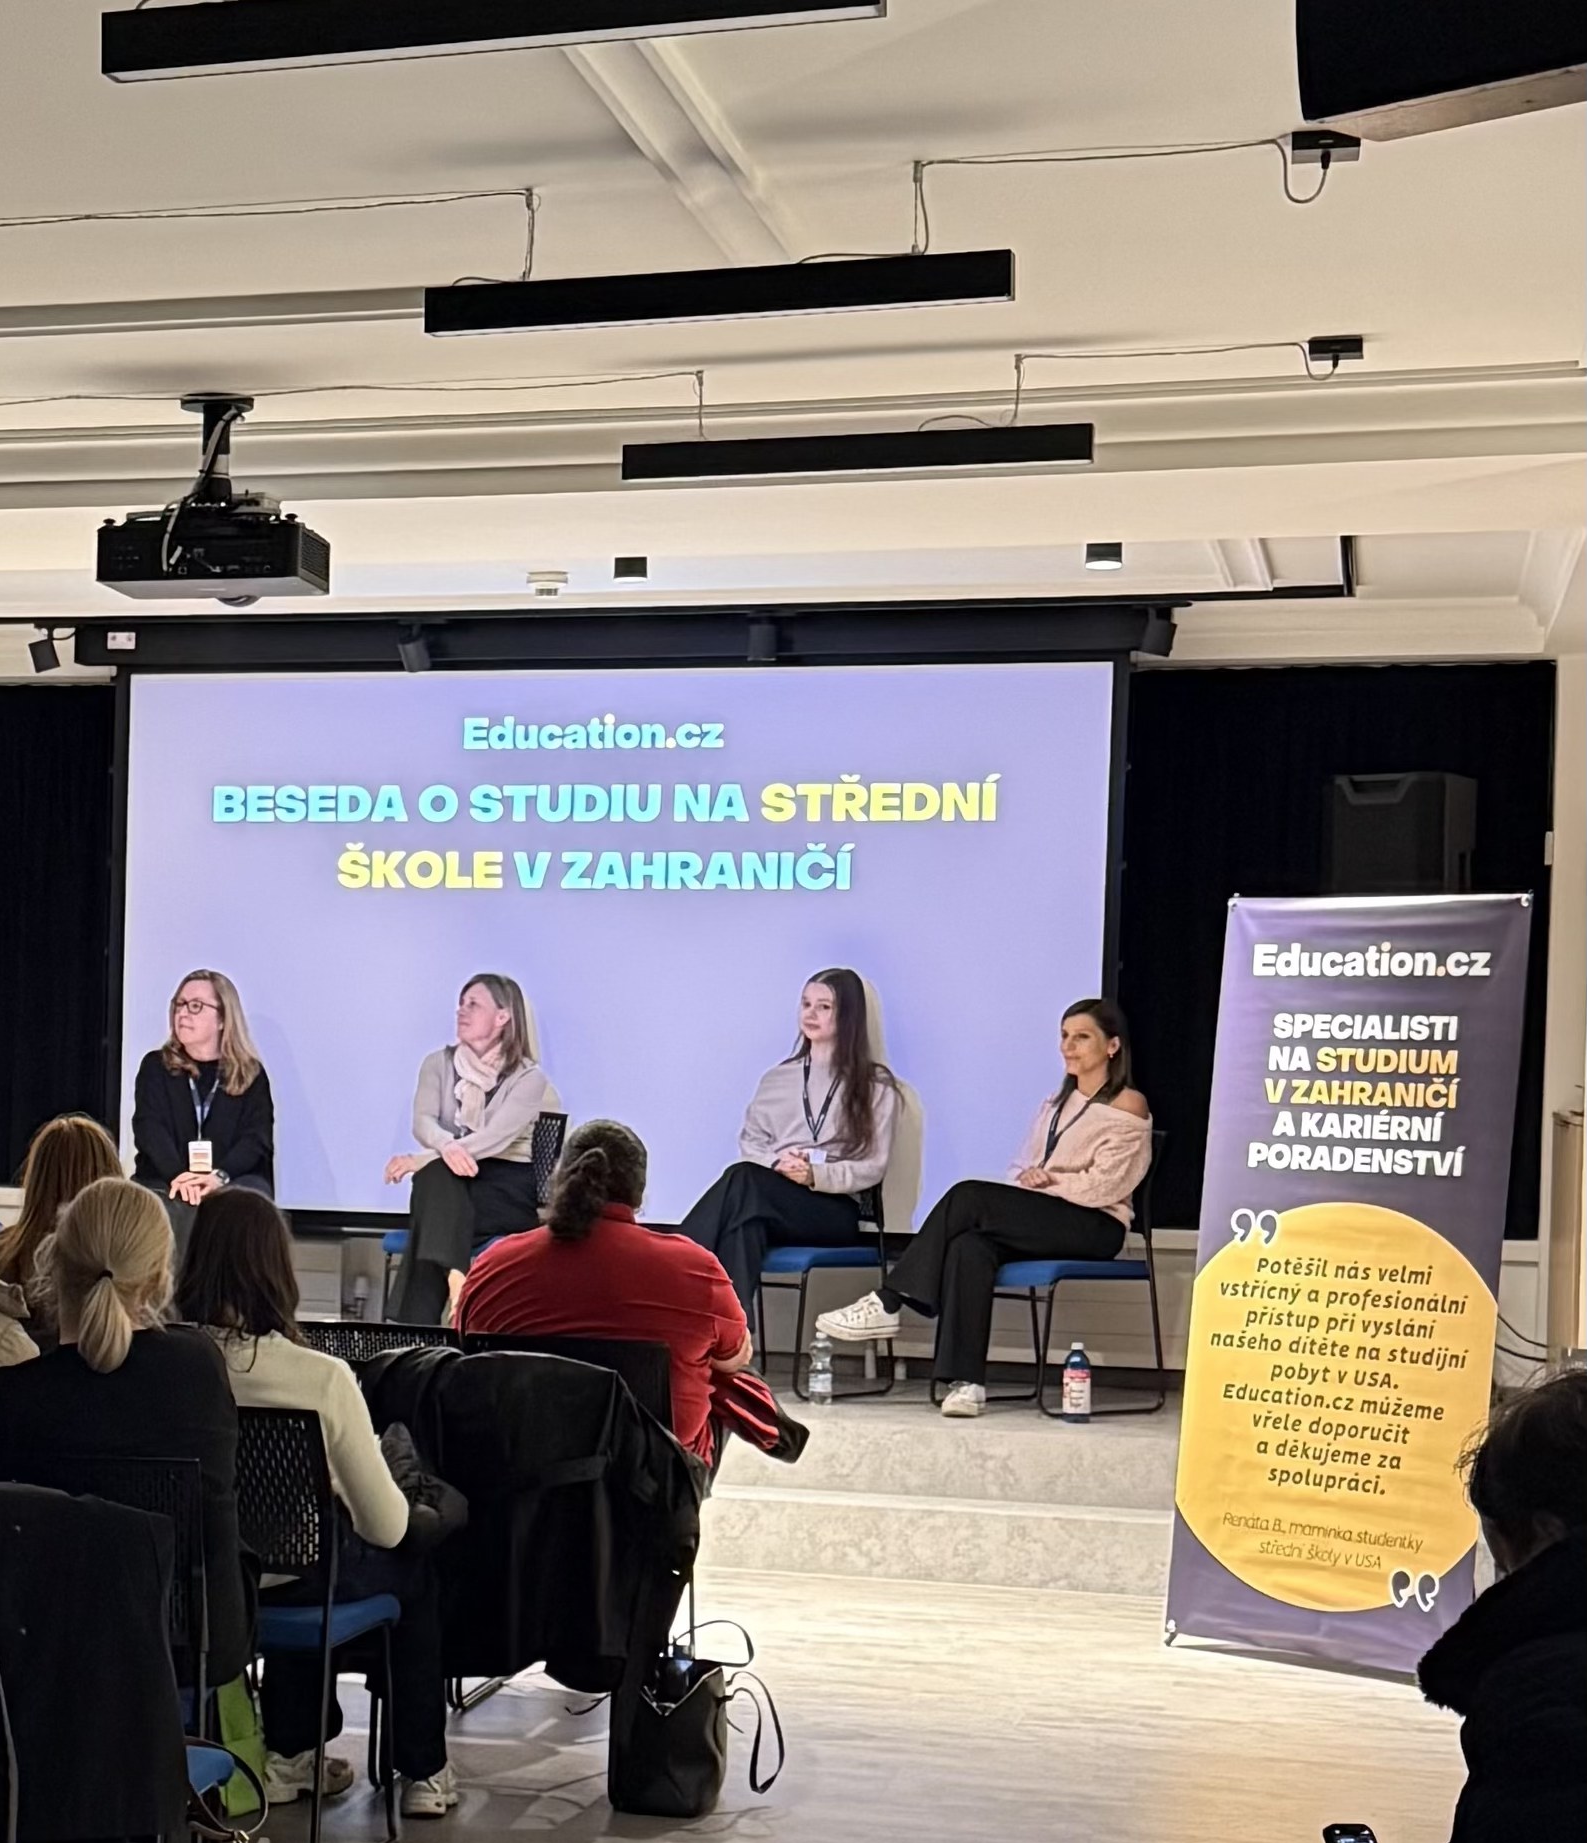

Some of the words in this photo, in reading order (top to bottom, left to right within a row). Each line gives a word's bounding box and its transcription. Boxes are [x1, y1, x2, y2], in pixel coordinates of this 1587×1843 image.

[462, 715, 724, 750] Education.cz
[213, 784, 409, 823] BESEDA
[418, 784, 464, 823] O
[469, 784, 661, 823] STUDIU
[673, 784, 749, 823] NA
[761, 773, 1002, 823] STŘEDNÍ
[337, 843, 504, 889] ŠKOLE
[512, 850, 552, 889] V
[560, 843, 854, 891] ZAHRANIČÍ
[1252, 941, 1492, 978] Education.cz
[1272, 1013, 1459, 1042] SPECIALISTI
[1268, 1046, 1311, 1072] NA
[1315, 1047, 1459, 1075] STUDIUM
[1264, 1077, 1287, 1104] V
[1289, 1077, 1461, 1109] ZAHRANIČÍ
[1271, 1111, 1296, 1137] A
[1300, 1110, 1446, 1142] KARIÉRNÍ
[1247, 1142, 1466, 1177] PORADENSTVÍ
[1257, 1257, 1328, 1279] Potěšil
[1334, 1260, 1371, 1281] nás
[1378, 1264, 1434, 1286] velmi
[1220, 1280, 1302, 1305] vstřícný
[1306, 1289, 1320, 1302] a
[1325, 1287, 1469, 1315] profesionální
[1245, 1306, 1320, 1333] přístup
[1325, 1312, 1357, 1335] při
[1361, 1317, 1437, 1339] vyslání
[1210, 1331, 1282, 1352] našeho
[1288, 1335, 1350, 1359] dítěte
[1355, 1345, 1382, 1361] na
[1387, 1346, 1469, 1371] studijní
[1270, 1362, 1331, 1385] pobyt
[1337, 1370, 1348, 1384] v
[1354, 1369, 1400, 1390] USA.
[1222, 1383, 1355, 1411] Education.cz
[1359, 1396, 1445, 1421] můžeme
[1252, 1410, 1303, 1432] vřele
[1308, 1416, 1411, 1444] doporučit
[1256, 1440, 1269, 1454] a
[1275, 1439, 1371, 1467] děkujeme
[1376, 1454, 1402, 1470] za
[1267, 1466, 1387, 1495] spolupráci.
[1222, 1511, 1270, 1531] Renáta
[1289, 1521, 1354, 1542] maminka
[1356, 1530, 1424, 1554] studentky
[1259, 1538, 1305, 1558] střední
[1307, 1545, 1342, 1567] školy
[1344, 1554, 1353, 1565] v
[1355, 1553, 1382, 1570] USA
